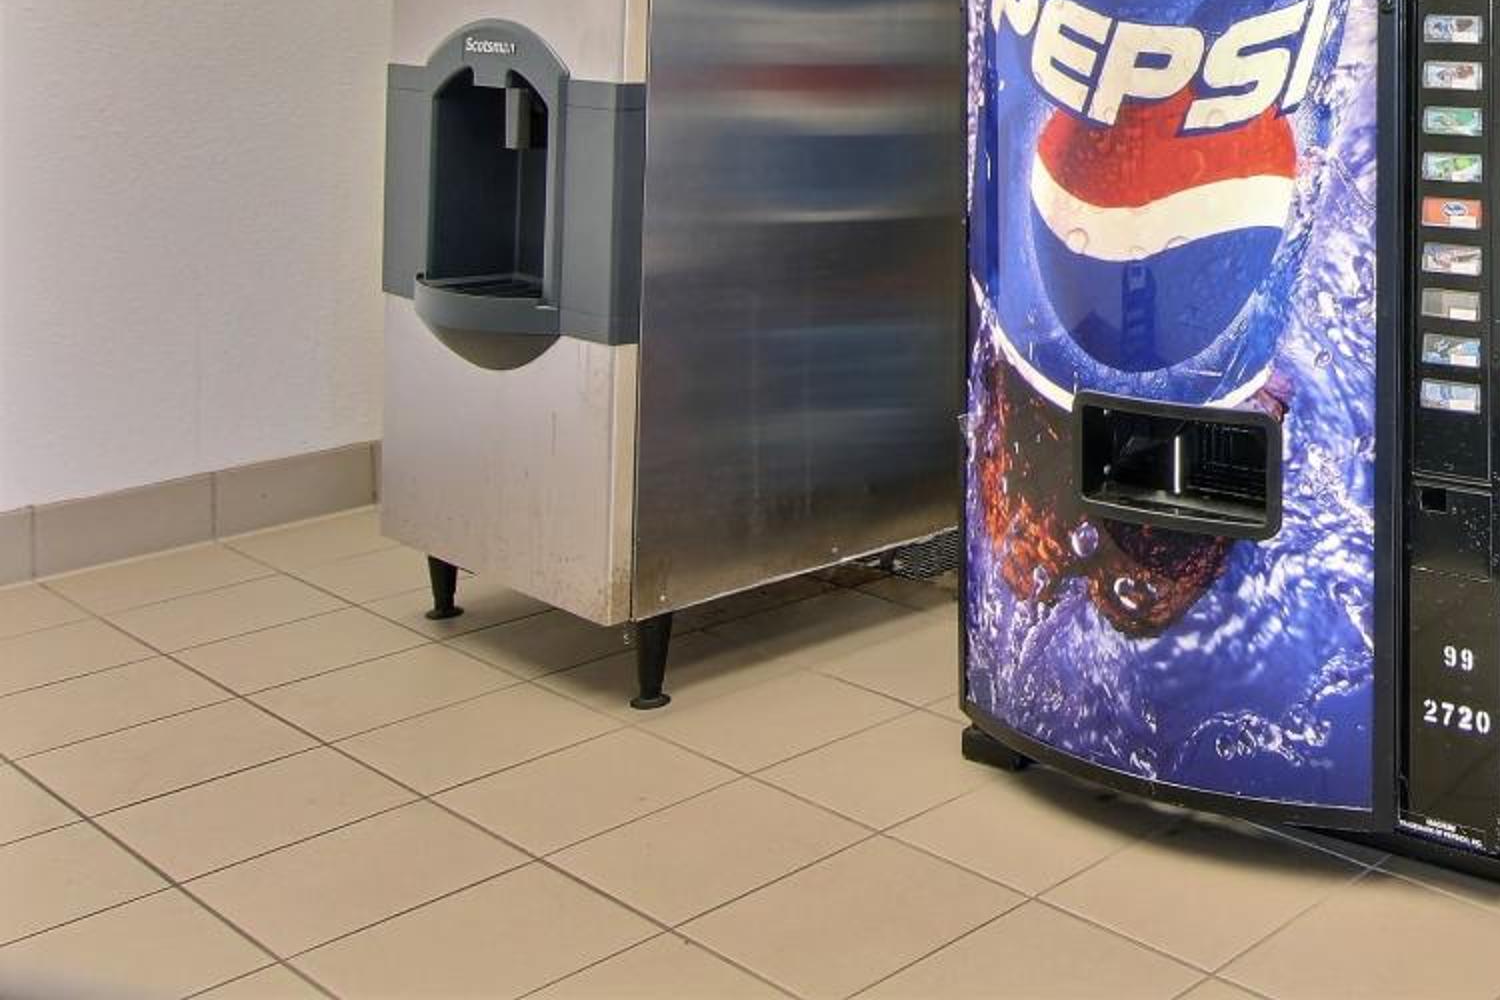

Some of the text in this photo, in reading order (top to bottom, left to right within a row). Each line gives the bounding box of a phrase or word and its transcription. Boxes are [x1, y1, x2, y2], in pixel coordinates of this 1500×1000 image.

[465, 36, 515, 54] Scotsman
[1443, 645, 1474, 672] 99
[1423, 699, 1492, 734] 2720
